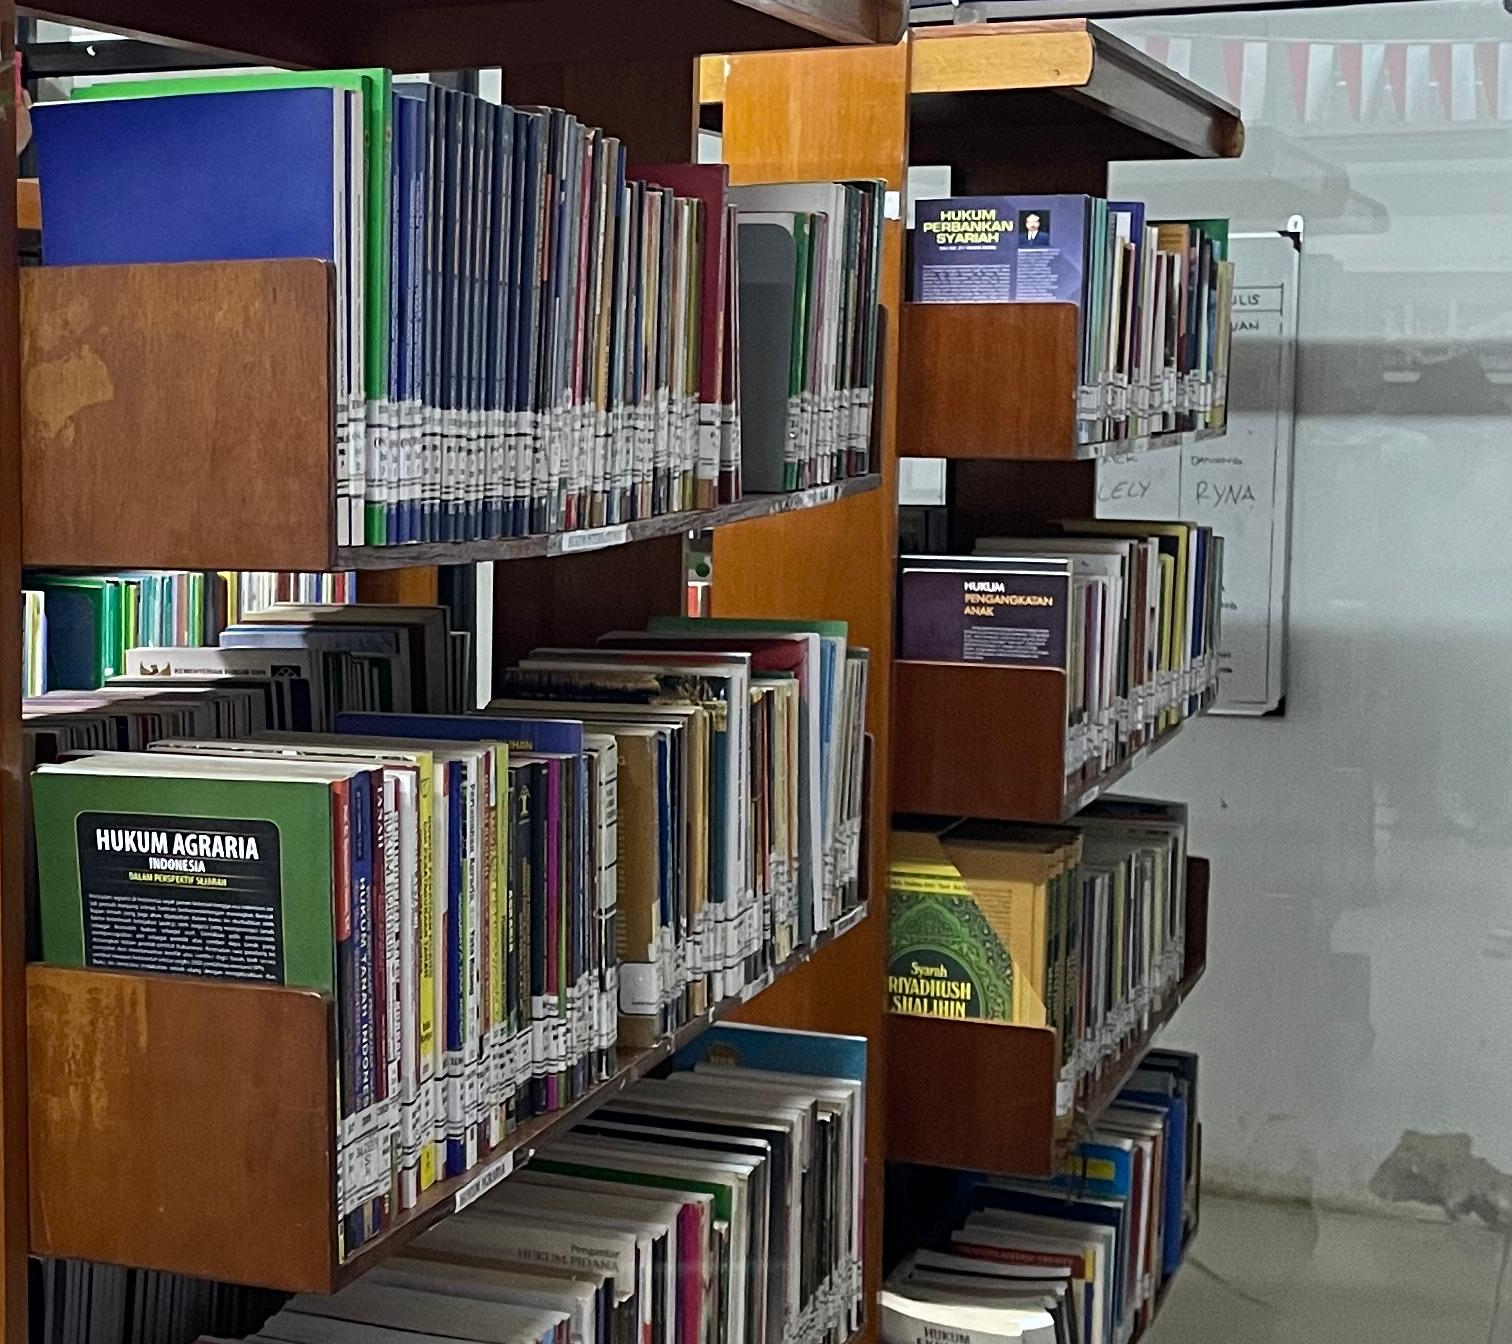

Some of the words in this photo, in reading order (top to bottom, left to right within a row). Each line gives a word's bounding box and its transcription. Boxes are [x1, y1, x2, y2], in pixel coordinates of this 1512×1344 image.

[940, 209, 996, 222] HUKUM
[923, 221, 1014, 233] PERBANKAN
[936, 233, 999, 244] SYARIAH
[1097, 481, 1151, 502] LELY
[1196, 481, 1256, 507] RYNA
[964, 582, 1006, 593] HUKUM
[964, 593, 1054, 607] PENGANGKATAN
[963, 606, 995, 617] ANAK
[96, 828, 169, 855] HUKUM
[172, 832, 260, 860] AGRARIA
[148, 857, 206, 873] INDONESIA
[358, 876, 369, 947] HUKUM
[888, 976, 971, 1001] RIYADHUSH
[570, 1256, 620, 1273] PIDANA
[924, 1326, 971, 1344] HUKUM
